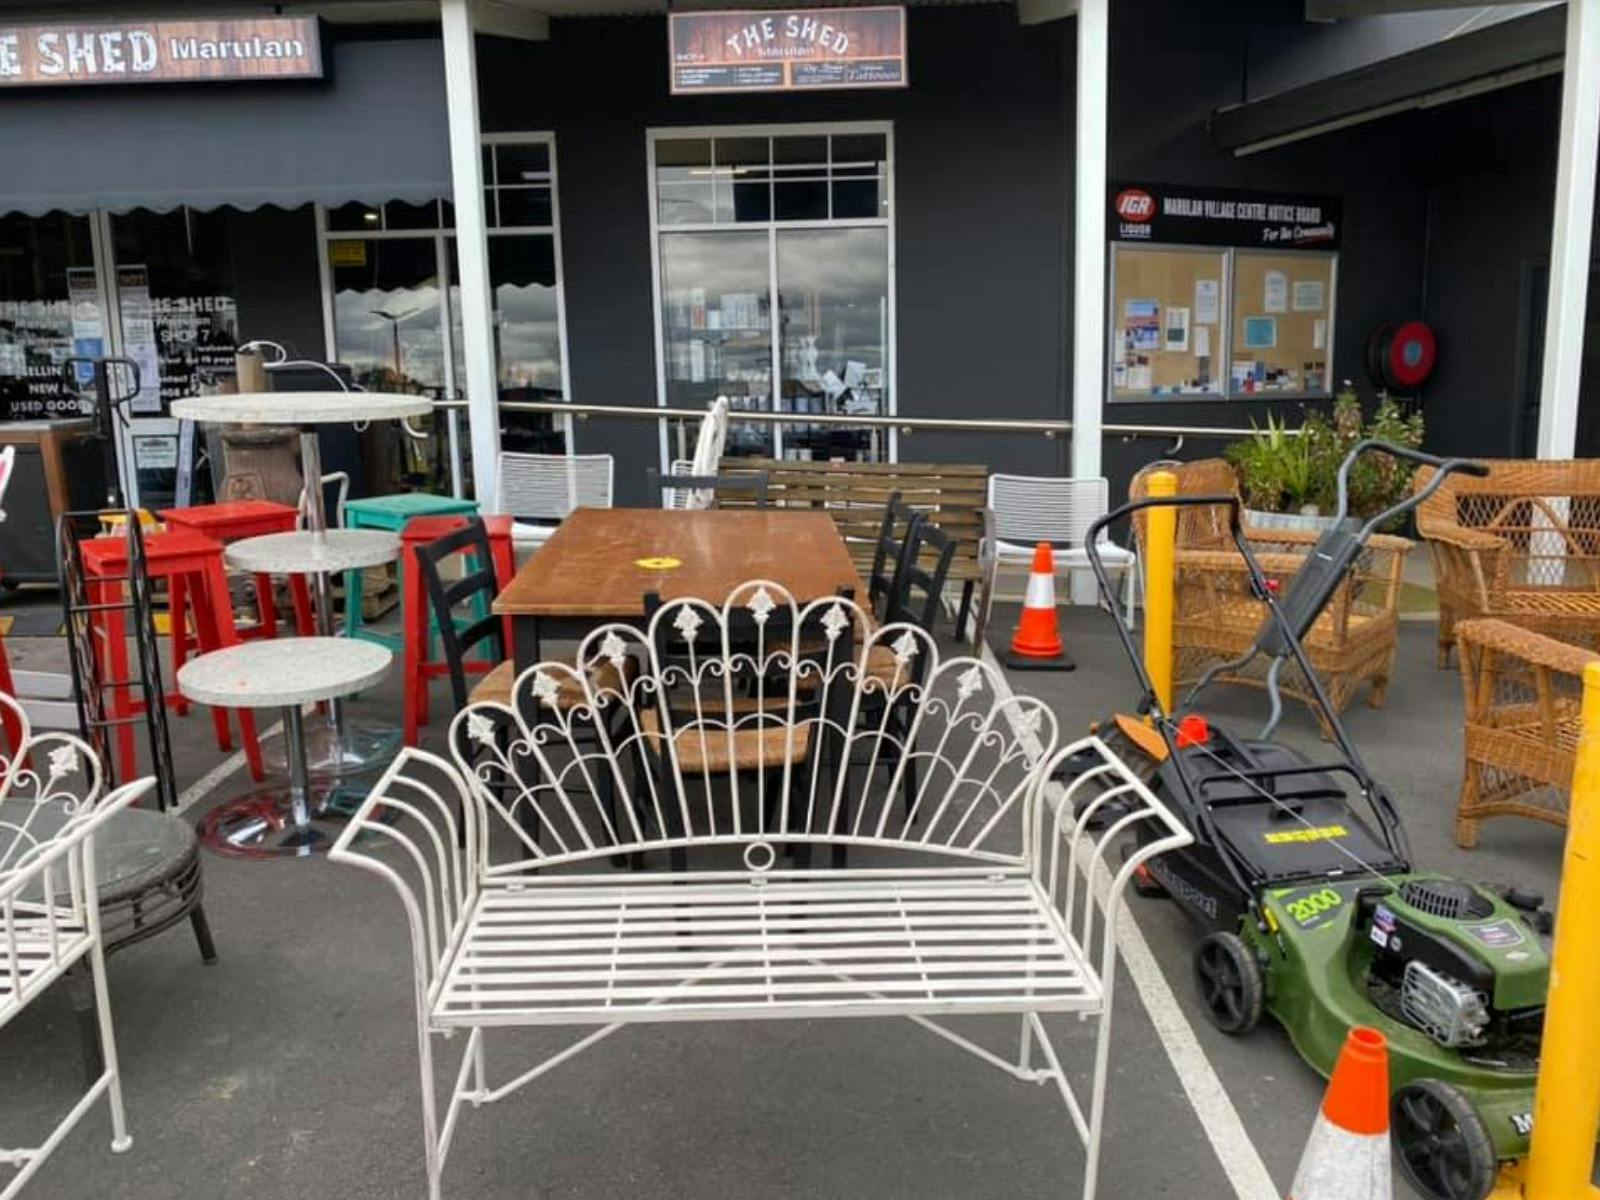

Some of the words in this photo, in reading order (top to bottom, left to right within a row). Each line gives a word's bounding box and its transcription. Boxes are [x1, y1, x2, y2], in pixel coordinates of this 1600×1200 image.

[726, 17, 775, 56] THE
[785, 15, 849, 54] SHED
[37, 31, 158, 75] SHED
[170, 37, 303, 60] Marulan
[1119, 195, 1151, 215] IGA
[1204, 200, 1236, 219] VILLAGE
[1237, 203, 1266, 221] CENTRE
[201, 330, 211, 342] 7
[29, 384, 58, 394] NEW
[11, 401, 43, 413] USED
[1286, 888, 1341, 920] 2000
